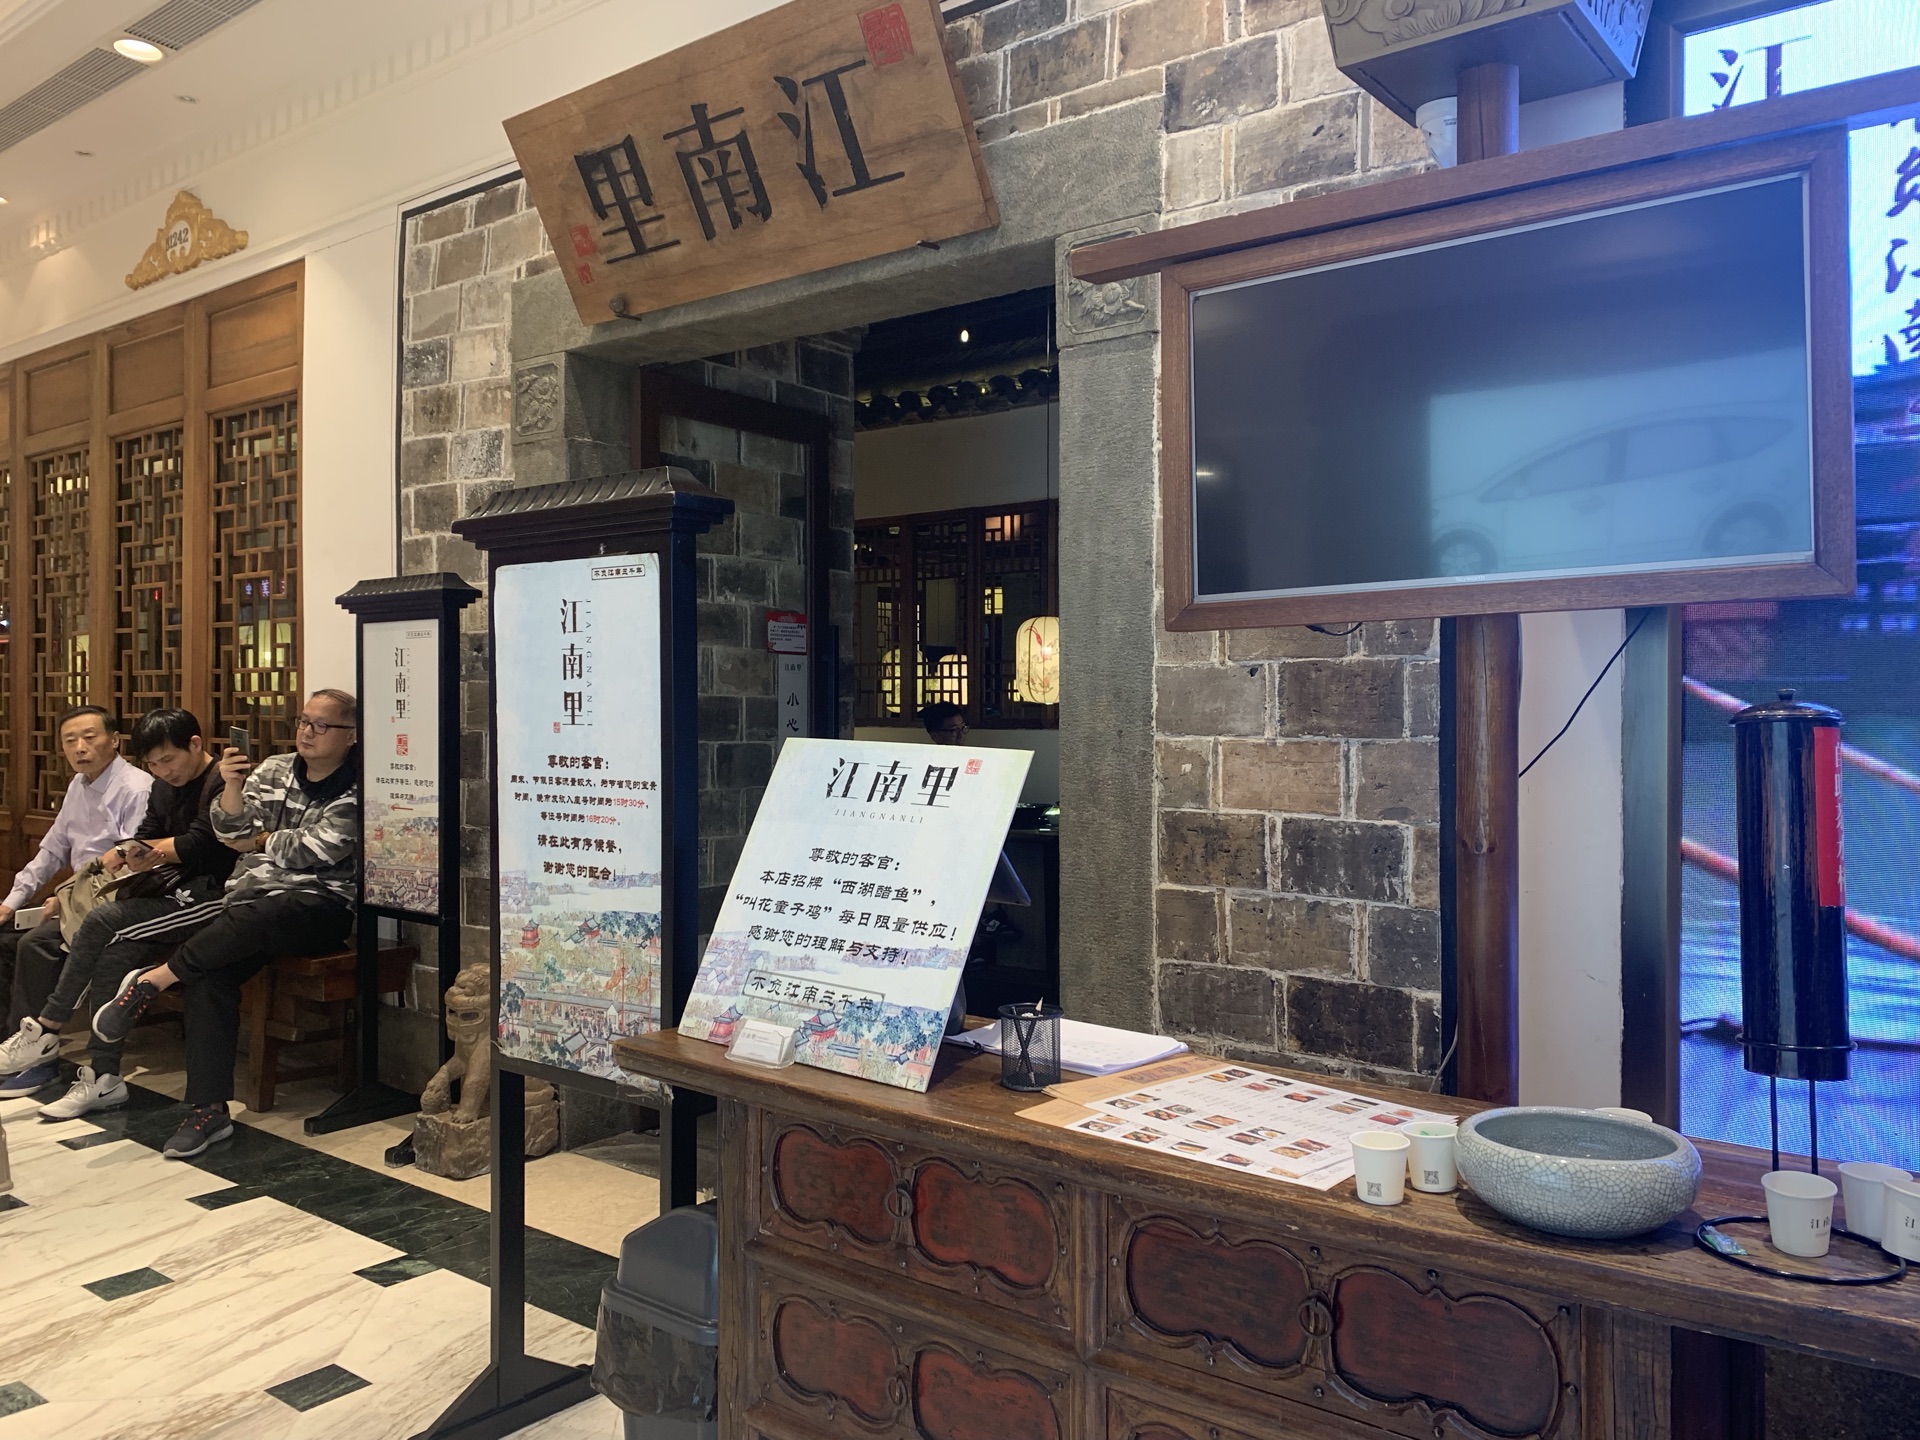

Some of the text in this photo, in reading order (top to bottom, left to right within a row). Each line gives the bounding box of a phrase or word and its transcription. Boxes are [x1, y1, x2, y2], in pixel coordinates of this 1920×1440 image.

[574, 59, 905, 264] 江南里
[560, 598, 584, 726] 江南里
[395, 647, 406, 719] 江南里
[787, 692, 799, 732] 小心
[547, 754, 609, 769] 尊敬的客官：
[826, 757, 959, 808] 江南里
[835, 808, 923, 824] JIANGNANLI
[537, 834, 622, 854] 请在此有序候餐，
[808, 847, 900, 871] 尊敬的客官：
[543, 861, 616, 881] 谢谢您的配合！
[747, 924, 909, 965] 感谢您的理解与支持！
[751, 976, 875, 1013] 不负江南三千年
